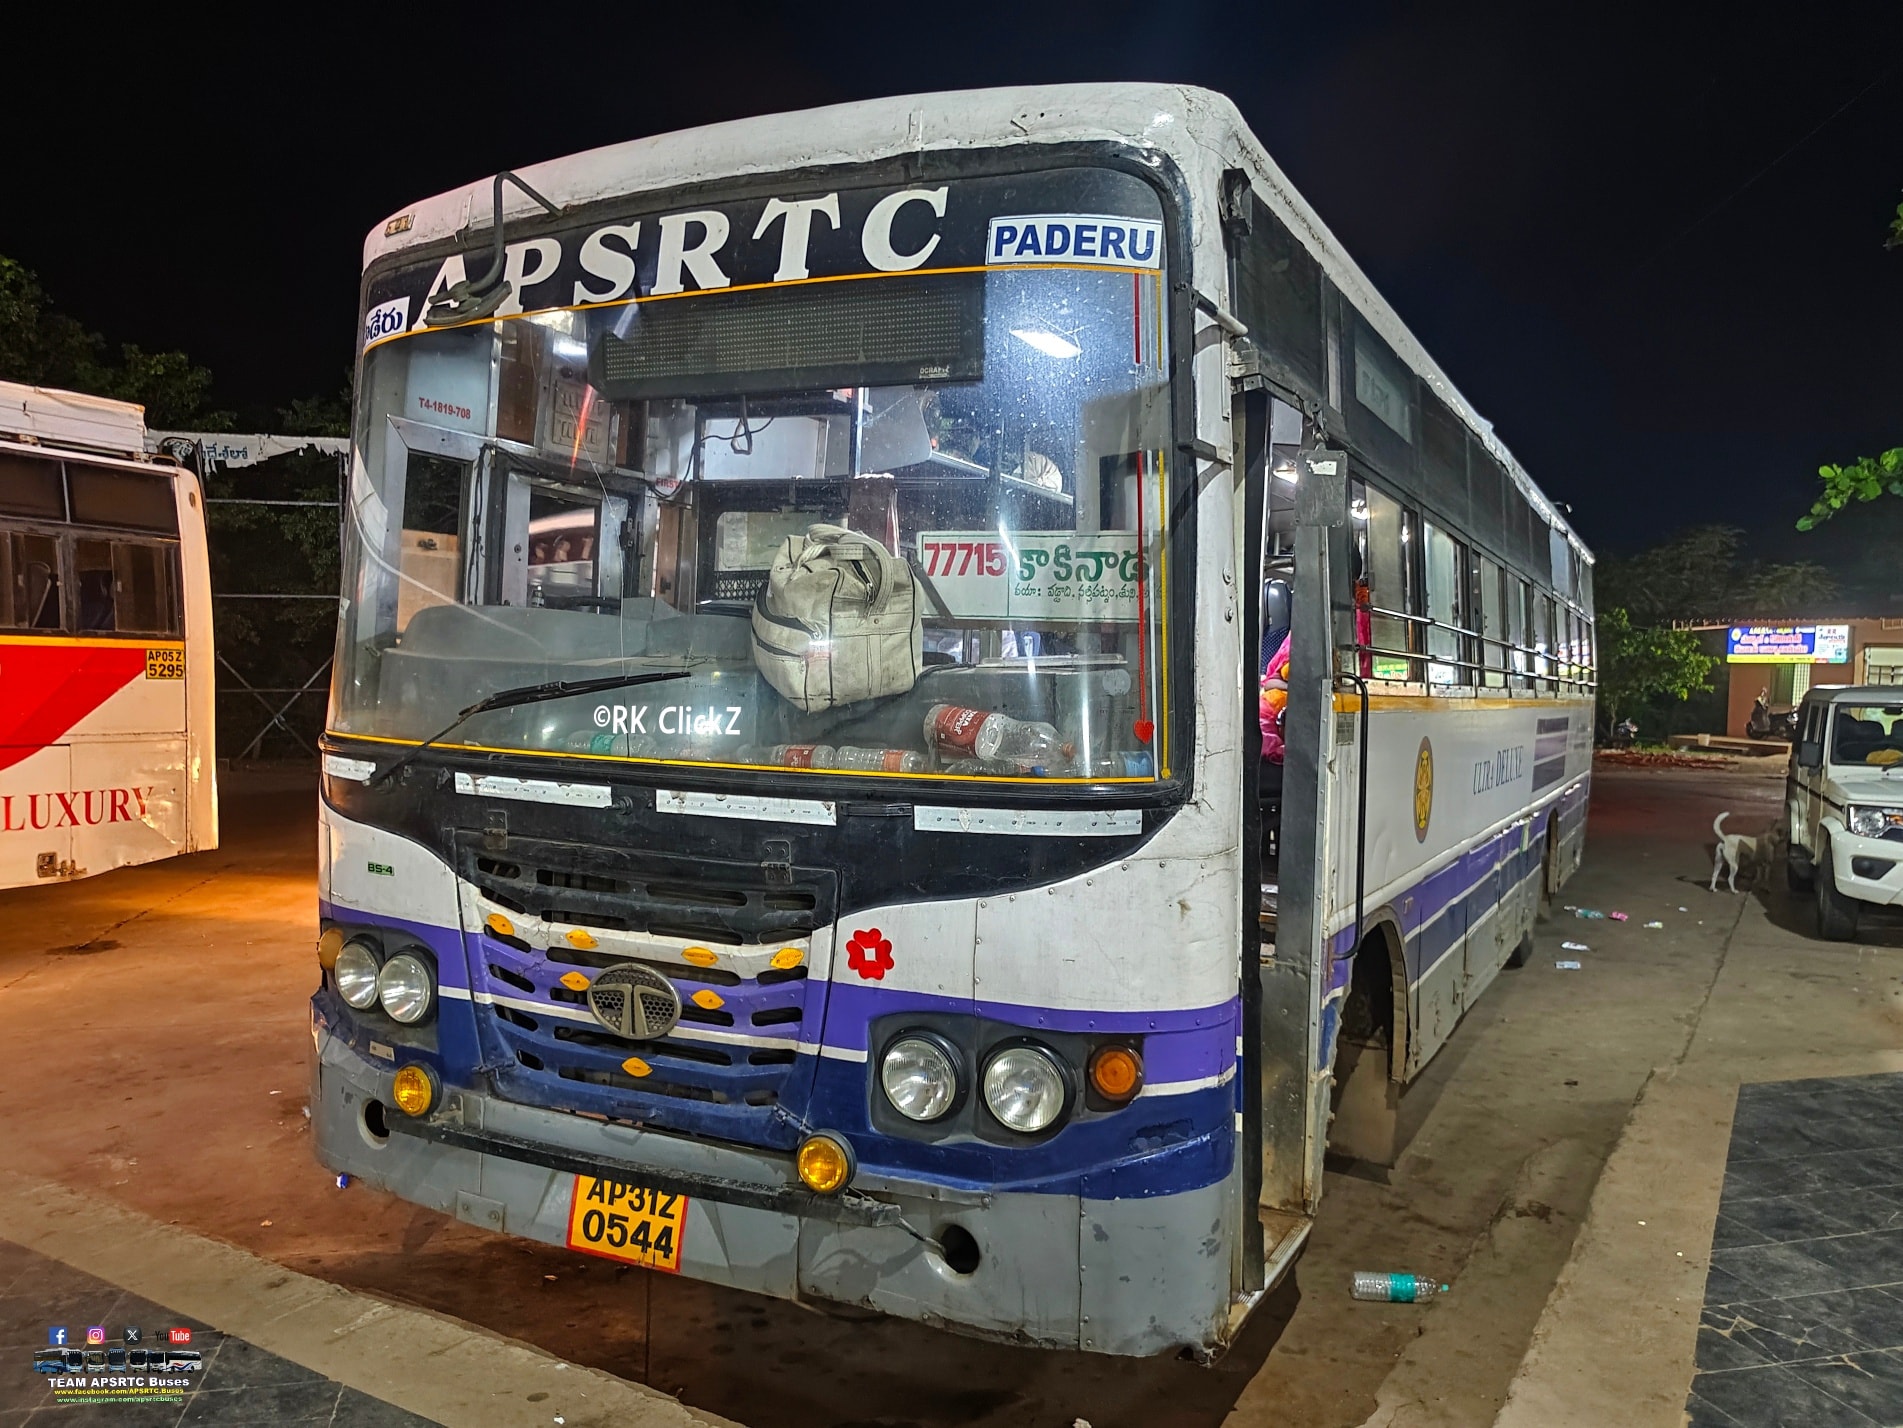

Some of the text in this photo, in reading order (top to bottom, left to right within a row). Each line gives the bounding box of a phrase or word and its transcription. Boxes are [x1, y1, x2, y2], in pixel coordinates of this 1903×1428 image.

[412, 187, 948, 332] APSRTC
[993, 223, 1156, 262] PADERU
[418, 396, 472, 419] T4-1819-708
[924, 543, 1007, 577] 77715
[1018, 544, 1150, 583] కాకినాడ
[149, 663, 184, 677] 5295
[1, 786, 154, 831] LUXURY
[367, 863, 393, 875] BS-4
[586, 1177, 678, 1220] AP31Z
[582, 1208, 674, 1260] 0544
